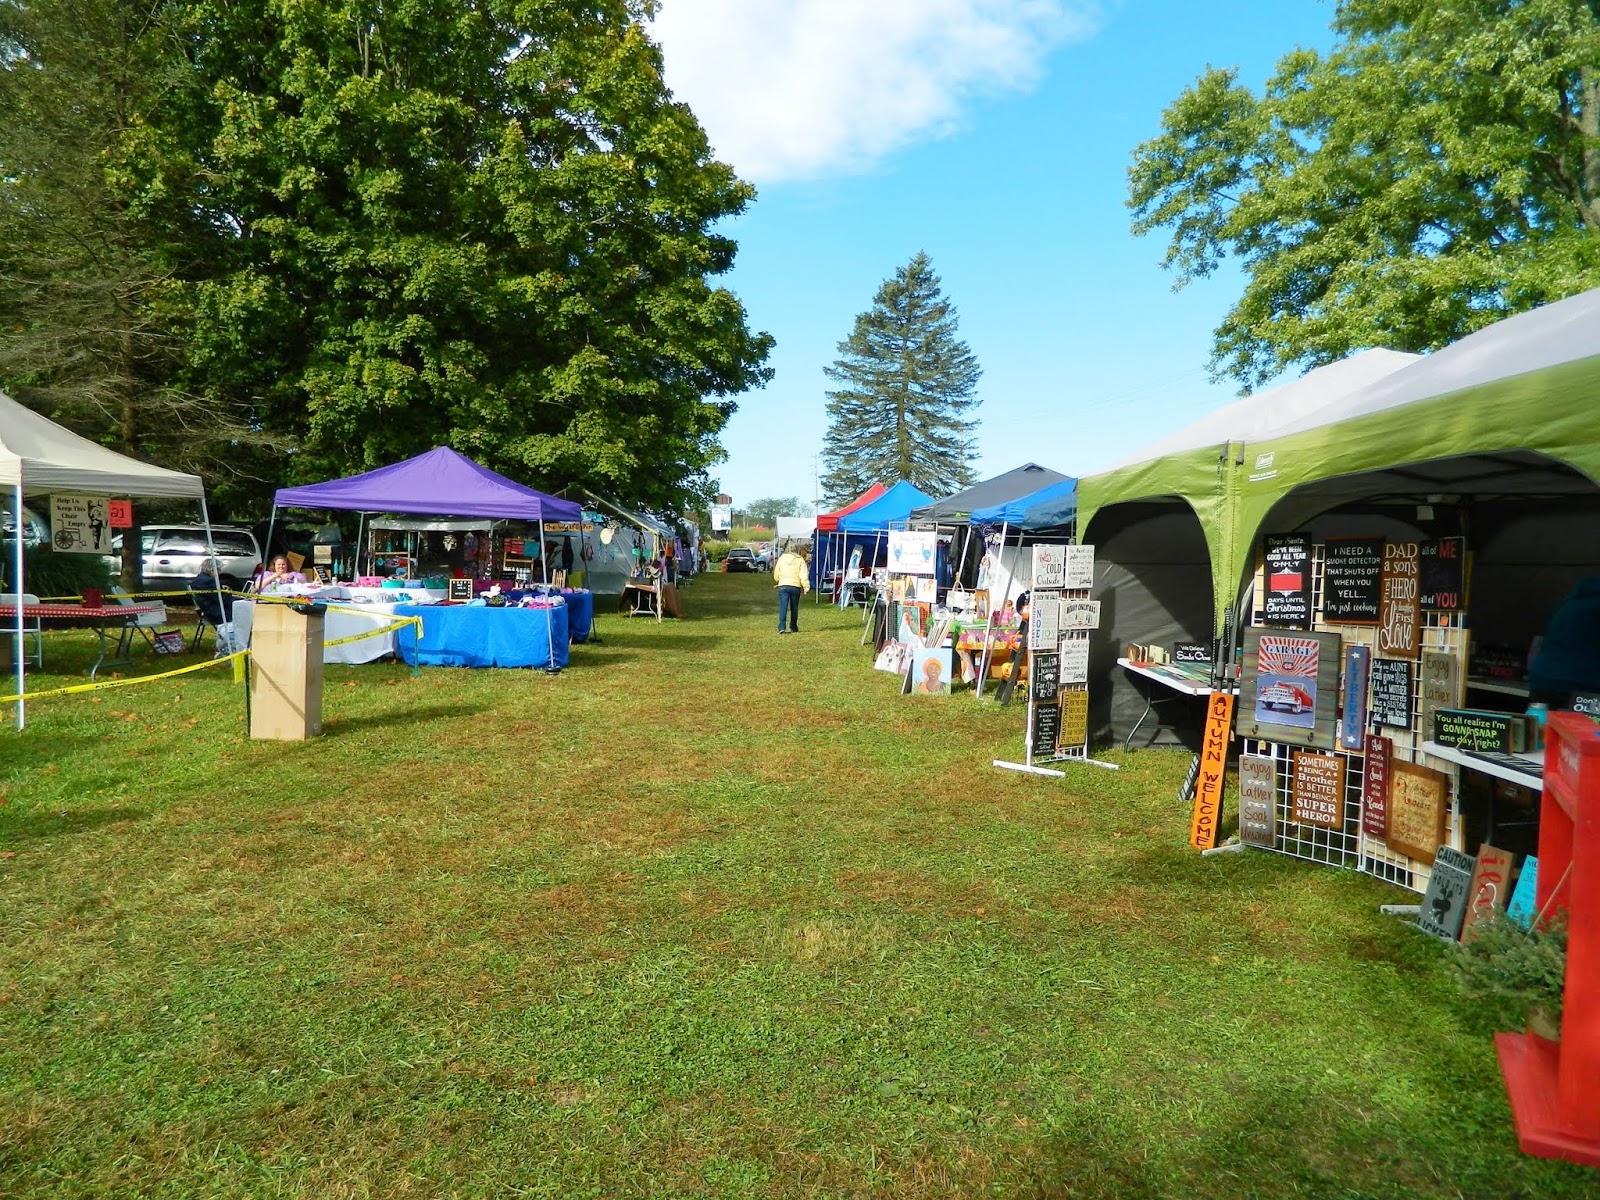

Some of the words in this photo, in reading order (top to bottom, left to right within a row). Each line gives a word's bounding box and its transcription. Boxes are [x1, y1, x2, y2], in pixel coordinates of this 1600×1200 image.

[111, 507, 125, 518] 21
[68, 521, 86, 529] Empty
[1267, 553, 1282, 561] GOOD
[1282, 553, 1292, 561] ALL
[1339, 547, 1364, 556] NEED
[1366, 547, 1373, 555] A
[1385, 544, 1418, 559] DAD
[1421, 546, 1430, 556] all
[1430, 546, 1437, 555] of
[1439, 541, 1457, 559] ME
[1348, 557, 1381, 565] DETECTOR
[1384, 562, 1390, 572] a
[1393, 558, 1418, 577] son's
[1047, 563, 1062, 574] COLD
[1327, 568, 1343, 576] THAT
[1344, 568, 1366, 576] SHUTS
[1367, 568, 1379, 576] OFF
[1037, 574, 1060, 586] Outside
[1338, 590, 1367, 599] YELL...
[1391, 578, 1417, 603] HERO
[1428, 595, 1435, 604] of
[1435, 592, 1457, 608] YOU
[1266, 603, 1306, 613] Christmas
[1338, 601, 1352, 615] just
[1380, 600, 1413, 651] Love
[1396, 613, 1414, 625] First
[1041, 630, 1055, 640] JOY
[1266, 645, 1314, 657] GARAGE
[1390, 663, 1408, 673] AUNT
[1426, 655, 1450, 680] Enjoy
[1373, 672, 1382, 681] can
[1383, 671, 1394, 685] give
[1036, 682, 1045, 693] For
[1389, 684, 1407, 696] MOTHER
[1425, 684, 1451, 703] Lather
[1348, 661, 1359, 734] LIBERTY
[1387, 700, 1407, 710] SISTER
[1061, 692, 1070, 744] THANKSGIVING
[1395, 709, 1407, 718] love
[1387, 715, 1407, 727] FRIEND
[1436, 714, 1452, 724] You
[1453, 716, 1463, 725] all
[1464, 718, 1491, 728] realize
[1492, 721, 1506, 730] I'm
[1207, 697, 1228, 763] AUTUMN
[1443, 724, 1472, 736] GONNA
[1474, 728, 1498, 739] SNAP
[1477, 739, 1501, 749] right?
[1243, 759, 1271, 781] Enjoy
[1298, 756, 1339, 771] SOMETIMES
[1304, 768, 1324, 776] BEING
[1298, 773, 1338, 787] Brother
[1241, 785, 1273, 802] Lather
[1297, 782, 1304, 790] IS
[1307, 783, 1338, 796] BETTER
[1298, 790, 1311, 798] THAN
[1312, 792, 1331, 801] BEING
[1197, 771, 1219, 848] WELCOME
[1297, 798, 1336, 814] SUPER
[1366, 796, 1384, 811] Knock
[1244, 807, 1268, 823] Soak
[1302, 811, 1330, 823] HERO
[1437, 847, 1474, 872] CAUTION
[1432, 873, 1451, 889] HOLD
[1453, 881, 1464, 896] ITS
